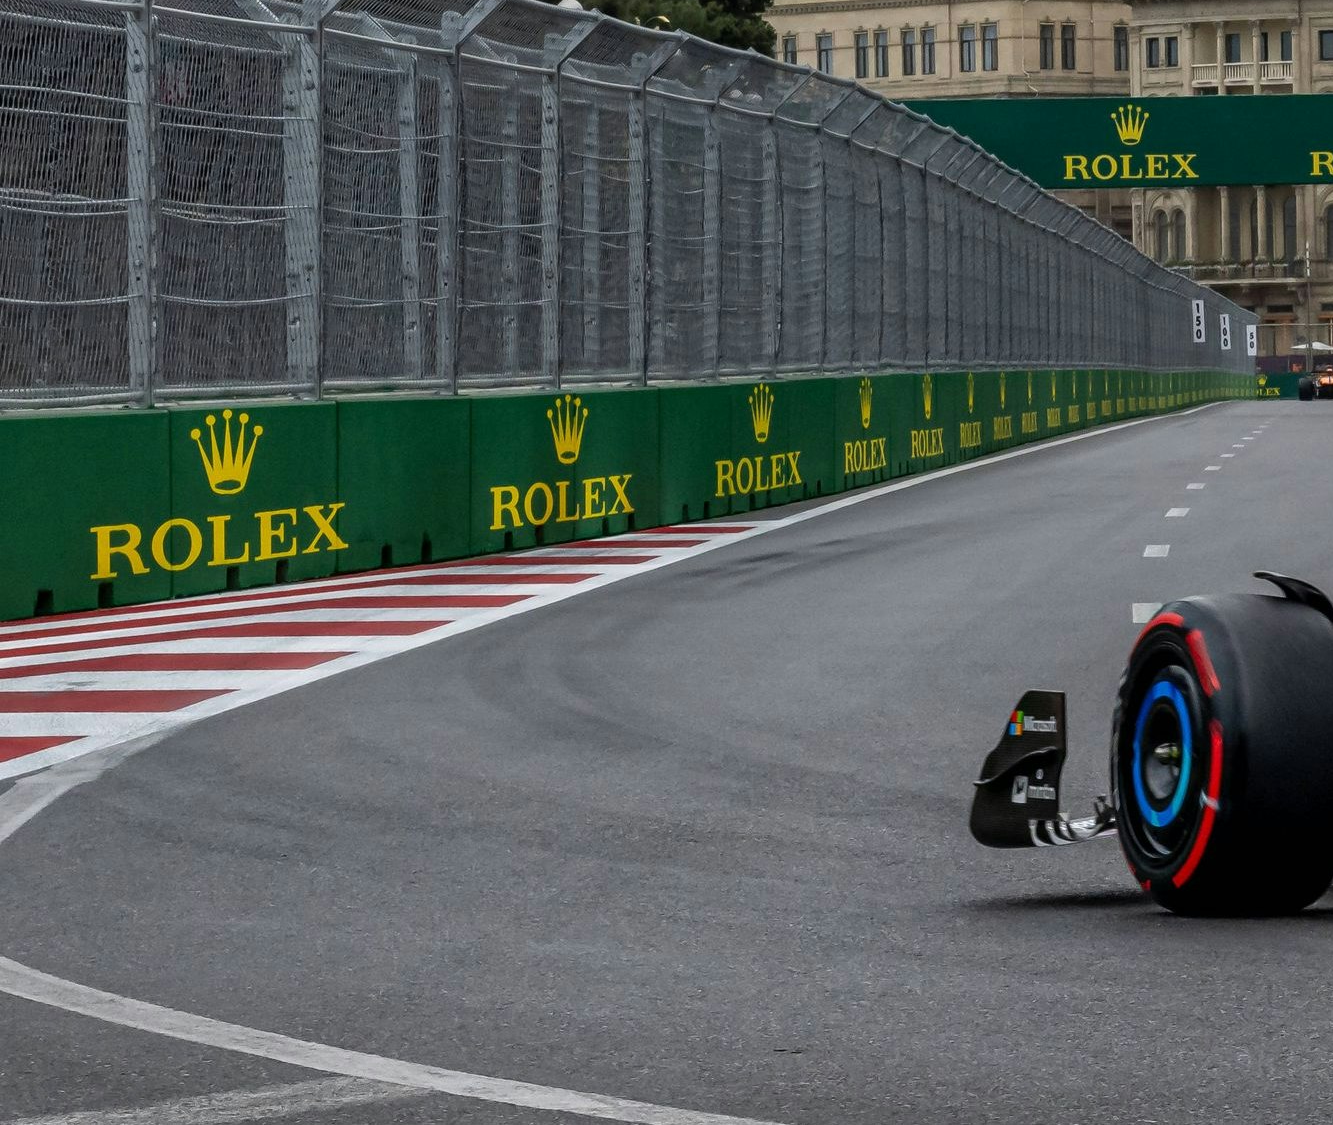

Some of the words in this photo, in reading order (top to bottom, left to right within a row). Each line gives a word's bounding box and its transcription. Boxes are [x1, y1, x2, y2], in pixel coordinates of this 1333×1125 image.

[1063, 154, 1199, 180] ROLEX
[1249, 332, 1255, 349] 50
[1257, 387, 1280, 396] LEX
[911, 427, 945, 459] ROLEX
[960, 420, 982, 448] ROLEX
[844, 437, 887, 474] ROLEX
[715, 451, 803, 497] ROLEX
[489, 473, 635, 531] ROLEX
[90, 501, 349, 581] ROLEX
